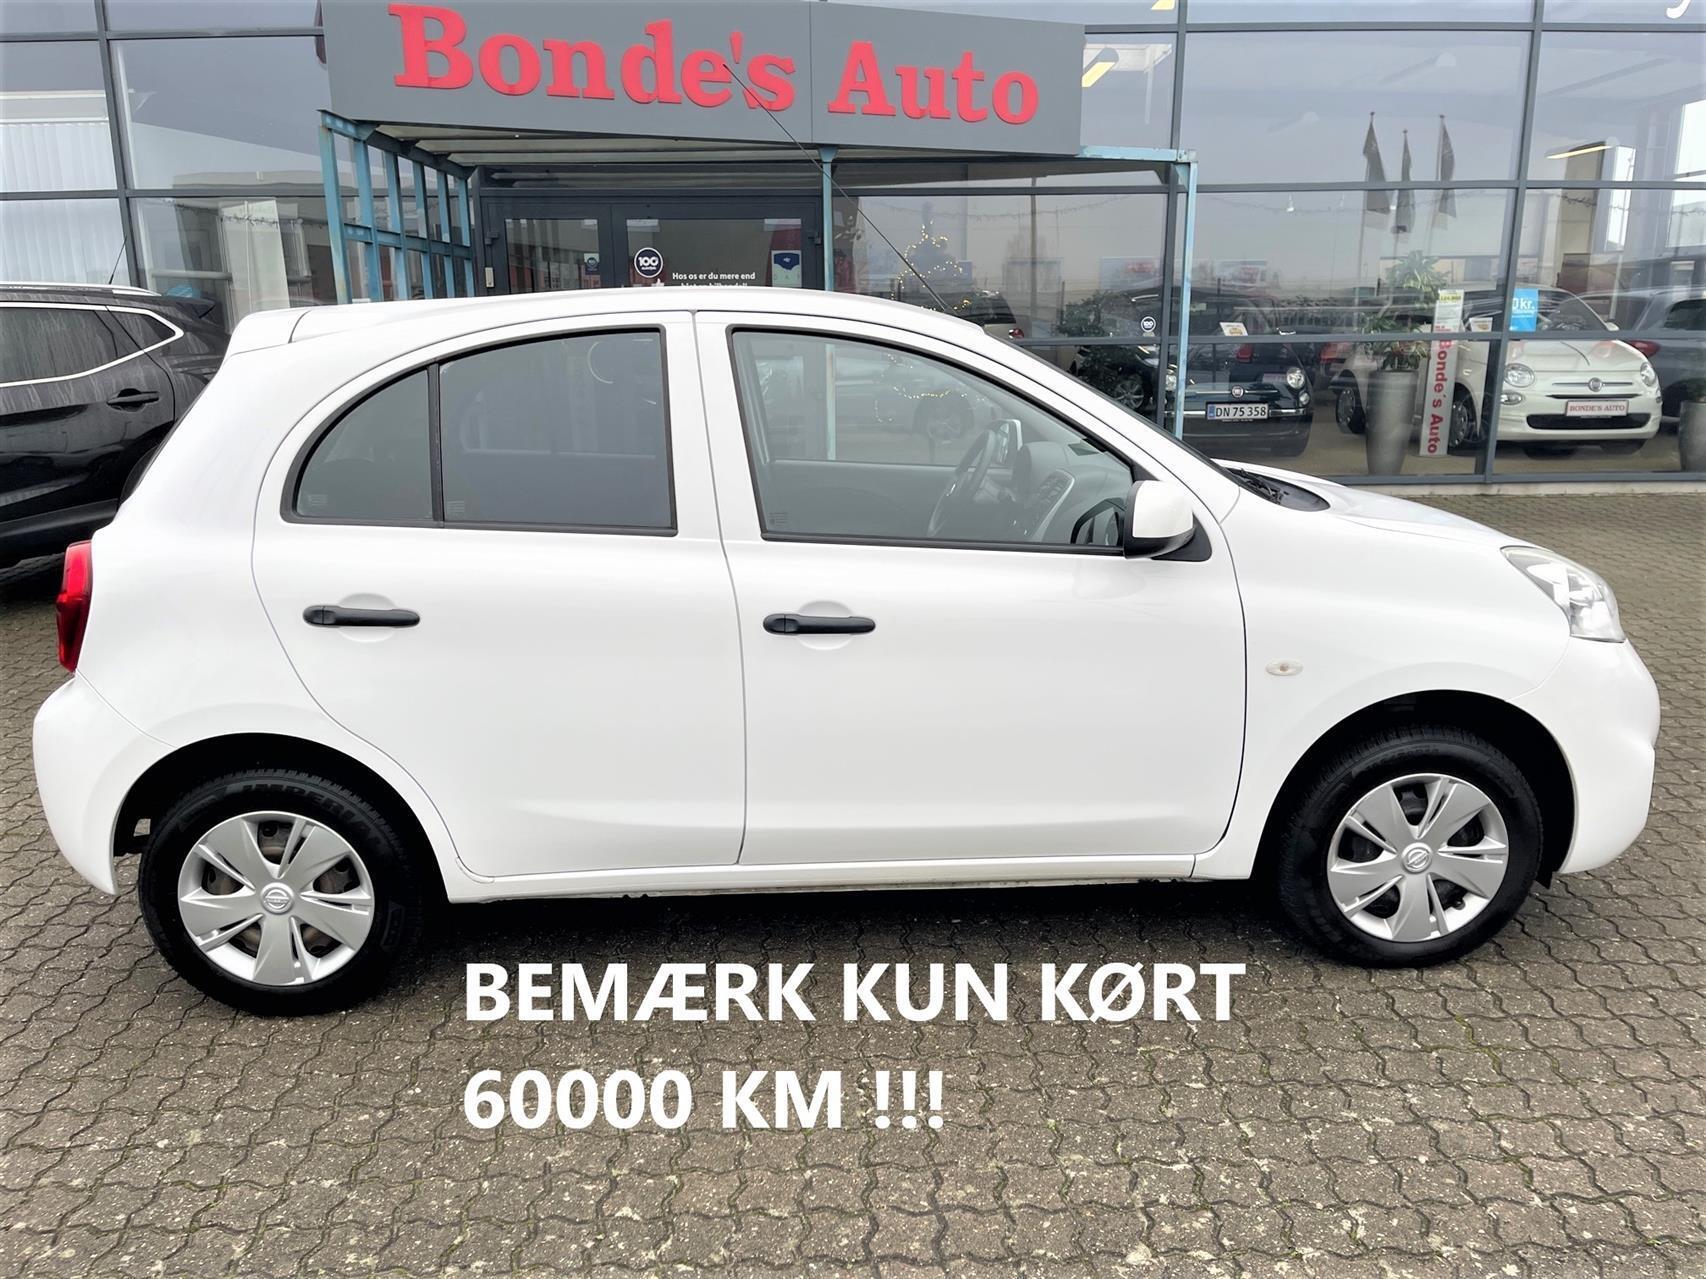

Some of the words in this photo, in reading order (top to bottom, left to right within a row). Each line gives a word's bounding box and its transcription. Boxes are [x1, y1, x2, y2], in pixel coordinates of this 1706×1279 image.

[389, 4, 795, 110] Bonde's
[828, 41, 1039, 125] Auto
[638, 256, 659, 267] 100
[672, 272, 687, 280] Hos
[708, 272, 718, 280] du
[741, 272, 756, 280] end
[1216, 407, 1230, 417] DN
[1232, 407, 1245, 417] 75
[1247, 406, 1267, 417] 358
[1604, 404, 1626, 412] AUTO
[1427, 413, 1443, 454] Auto
